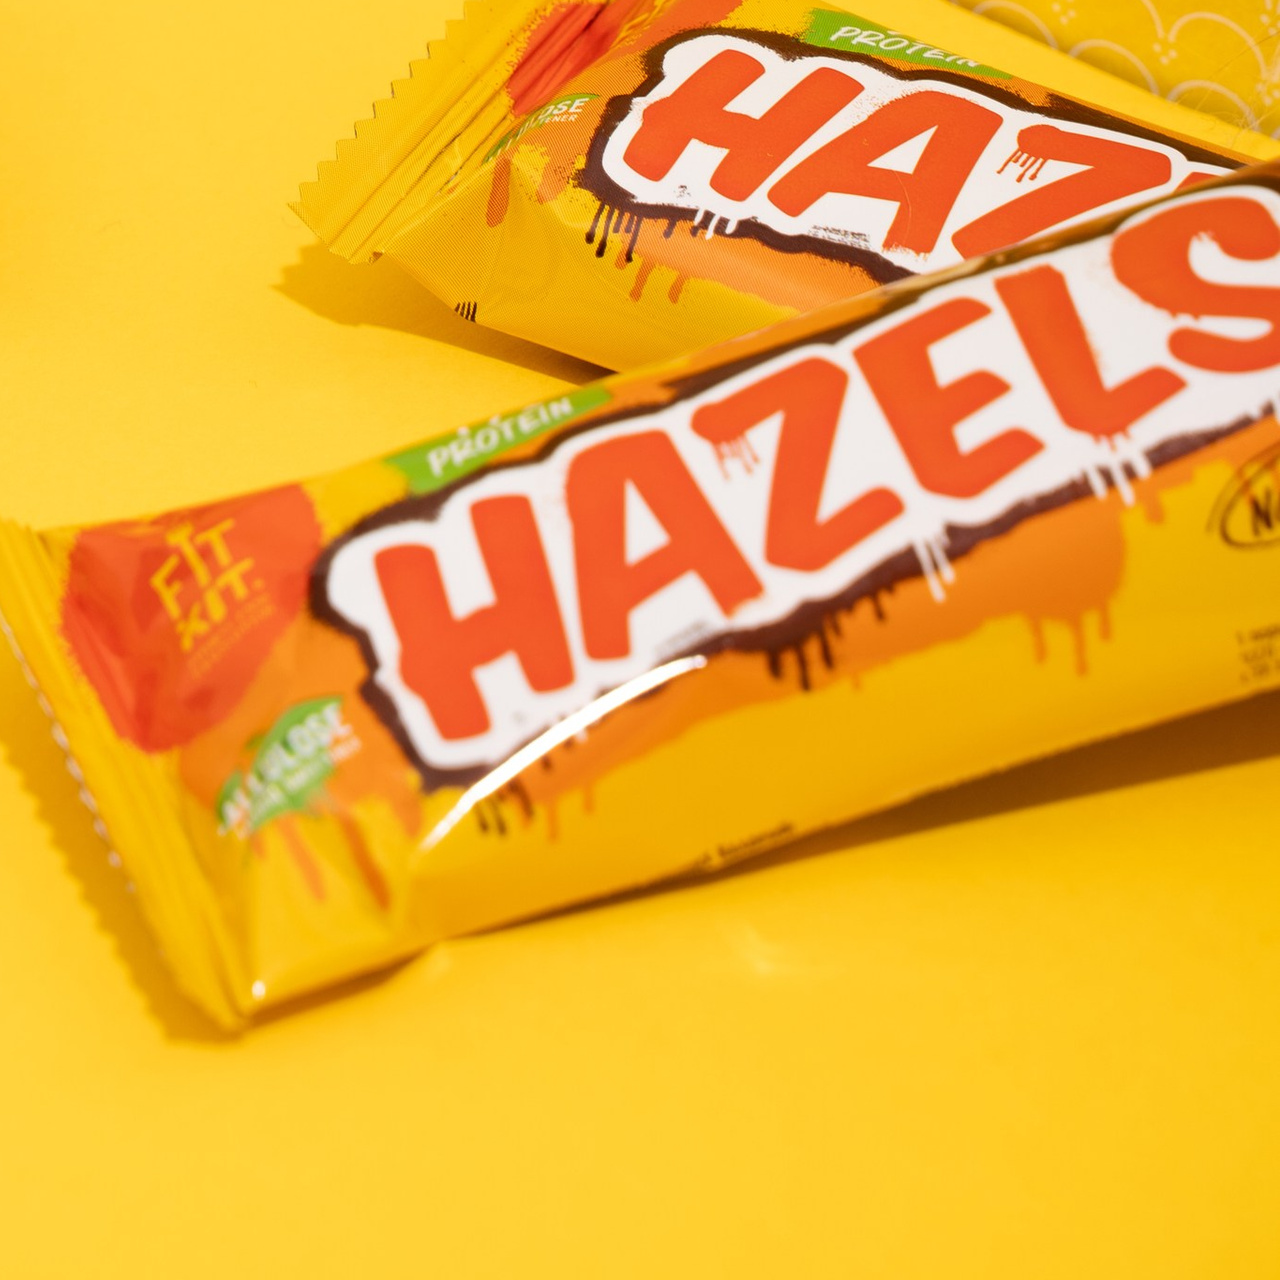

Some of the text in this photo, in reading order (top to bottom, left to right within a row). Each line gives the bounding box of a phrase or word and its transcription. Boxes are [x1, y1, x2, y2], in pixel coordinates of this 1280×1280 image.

[622, 48, 1225, 261] HAZ
[373, 195, 1280, 743] HAZELS
[427, 397, 573, 477] PROTEIN
[149, 517, 236, 620] FIT
